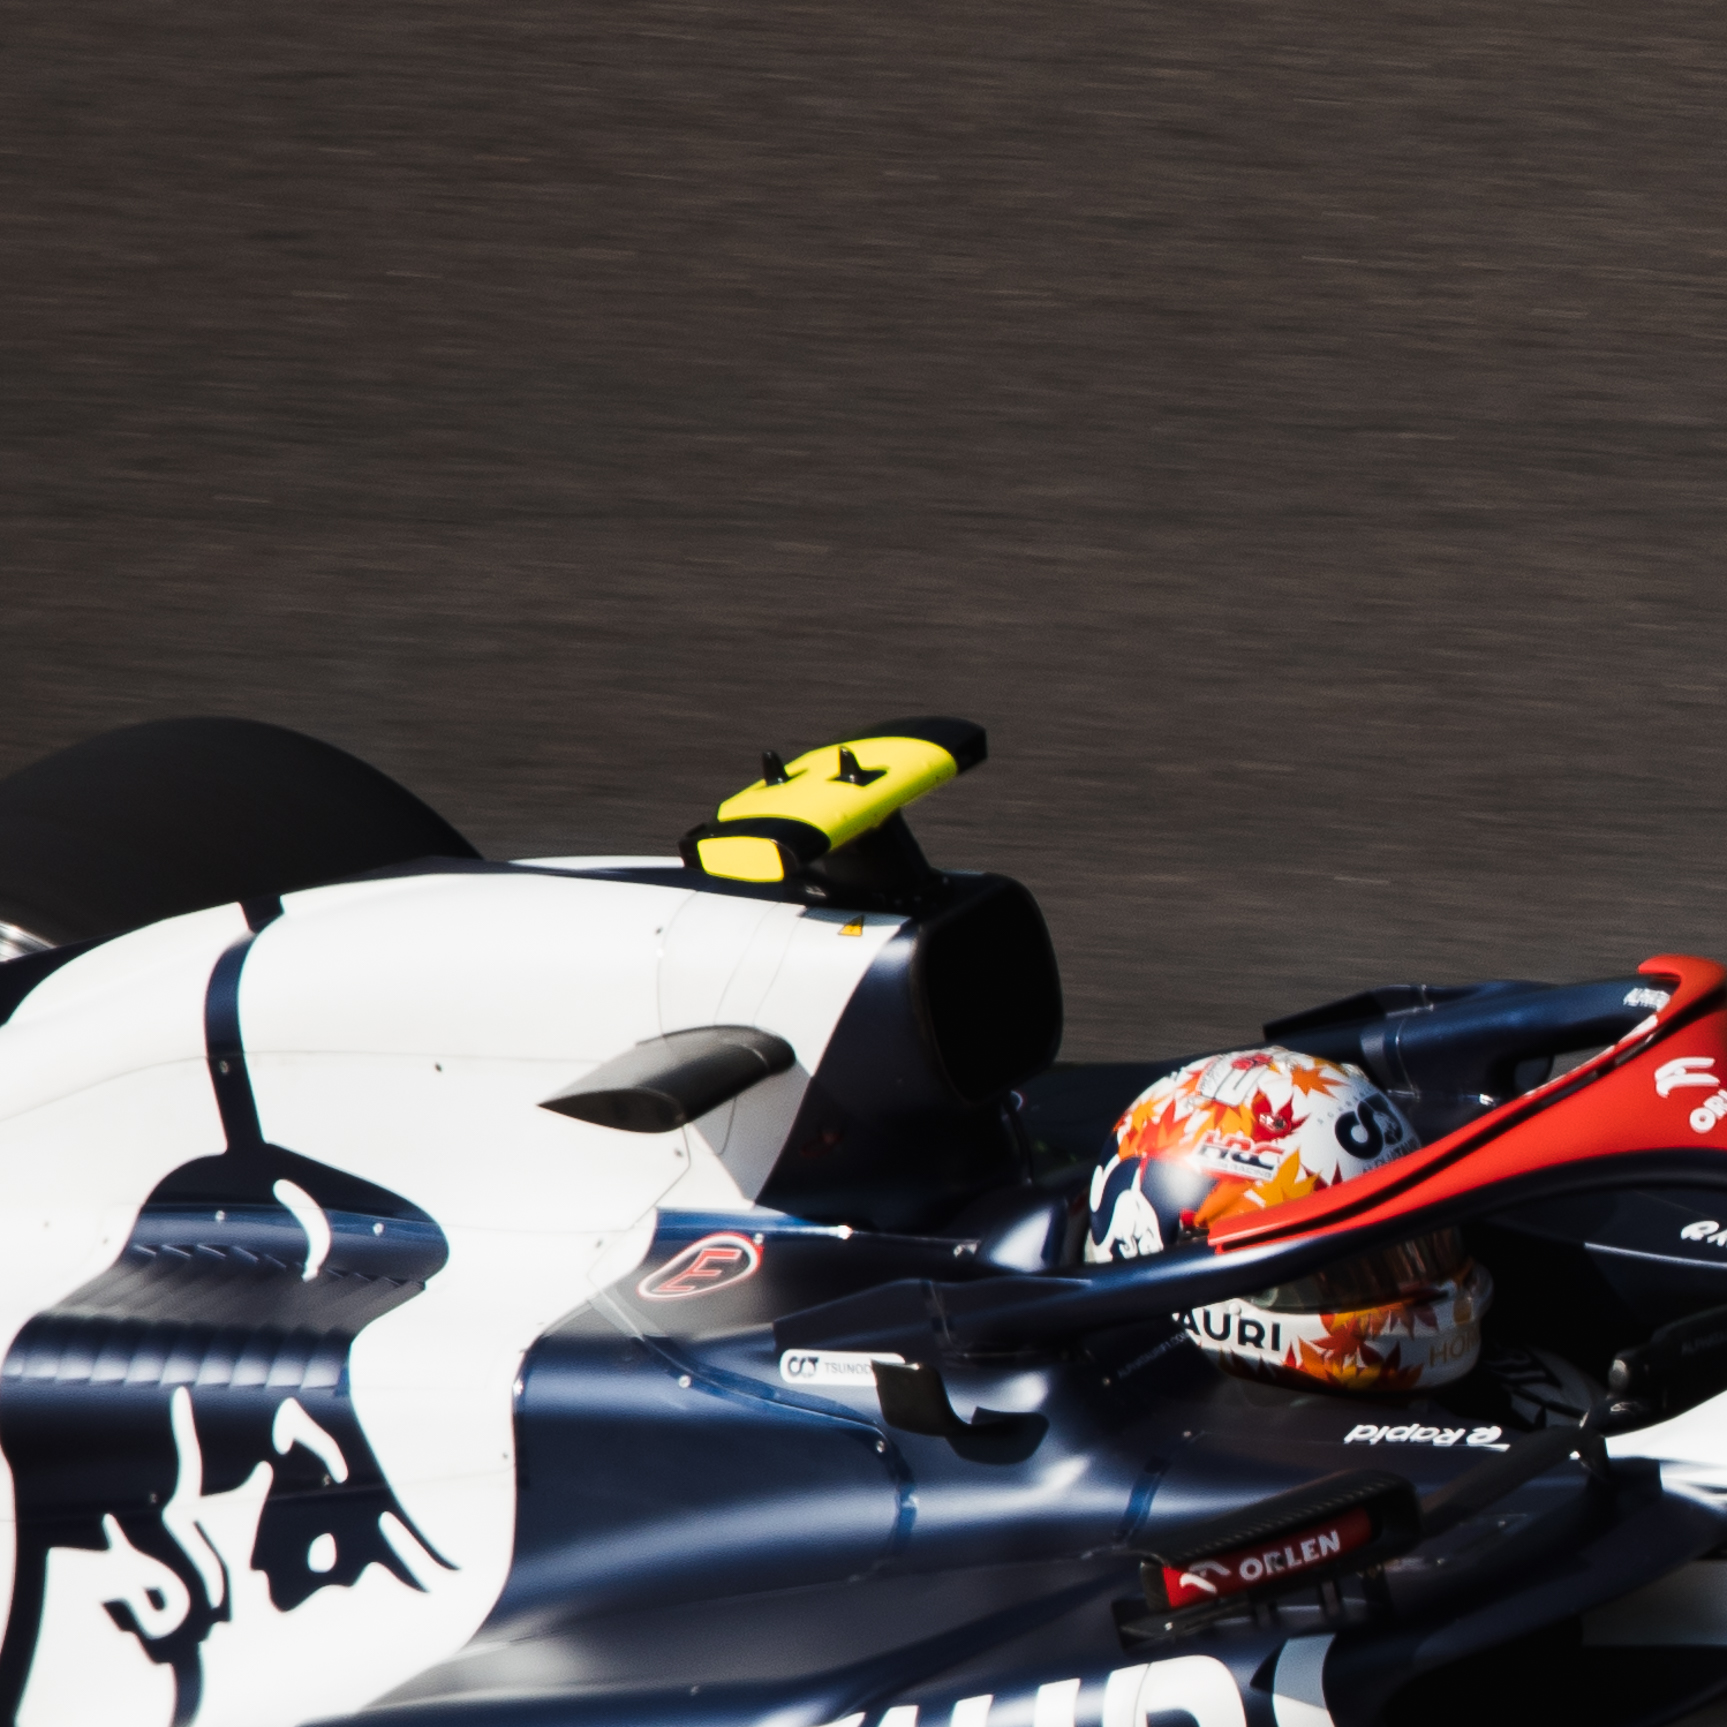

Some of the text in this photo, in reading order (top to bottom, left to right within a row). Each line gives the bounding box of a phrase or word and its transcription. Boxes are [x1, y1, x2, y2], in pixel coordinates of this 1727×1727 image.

[1176, 1308, 1281, 1352] AURI
[825, 1361, 872, 1376] TSUNOD
[1344, 1422, 1467, 1448] Rapid
[1238, 1530, 1342, 1583] ORLEN
